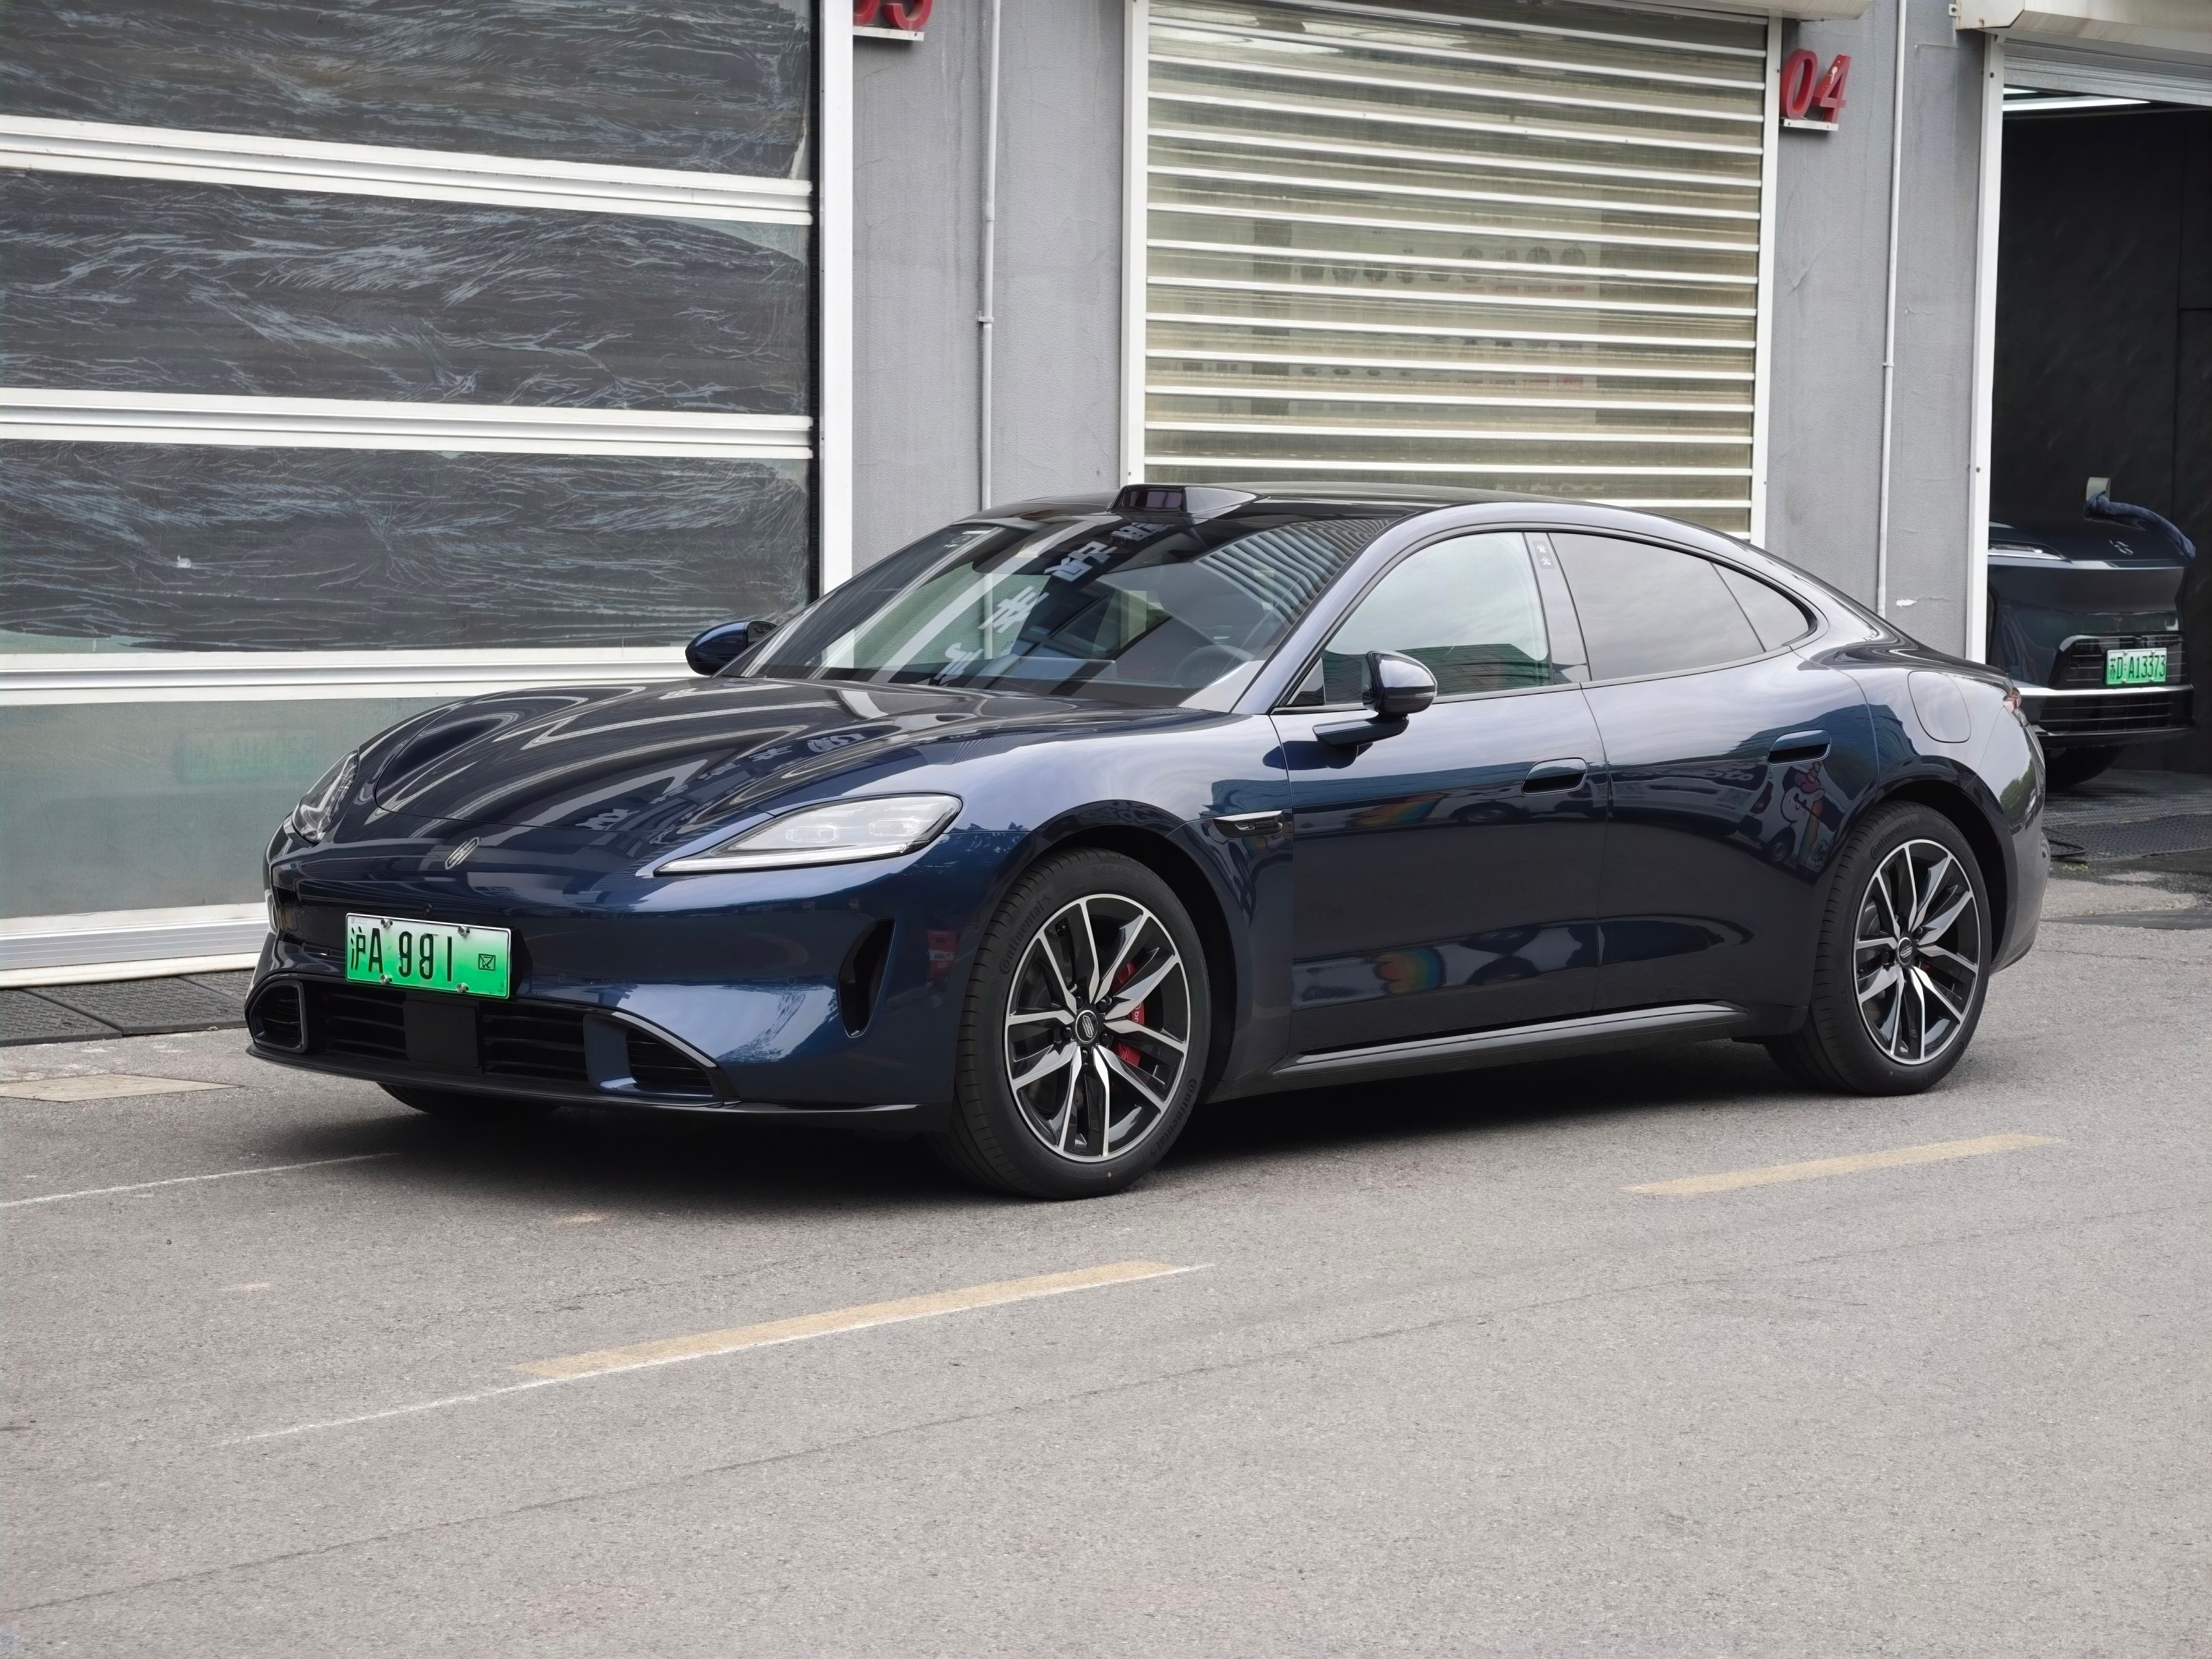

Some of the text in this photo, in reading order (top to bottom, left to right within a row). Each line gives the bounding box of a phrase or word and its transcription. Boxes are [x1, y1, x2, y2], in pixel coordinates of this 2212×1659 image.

[1781, 49, 1851, 124] 04
[2128, 655, 2166, 679] A13373
[1870, 819, 1910, 860] Continental
[350, 926, 383, 973] 沪A
[999, 900, 1044, 975] Continental
[1157, 1078, 1197, 1150] Continental
